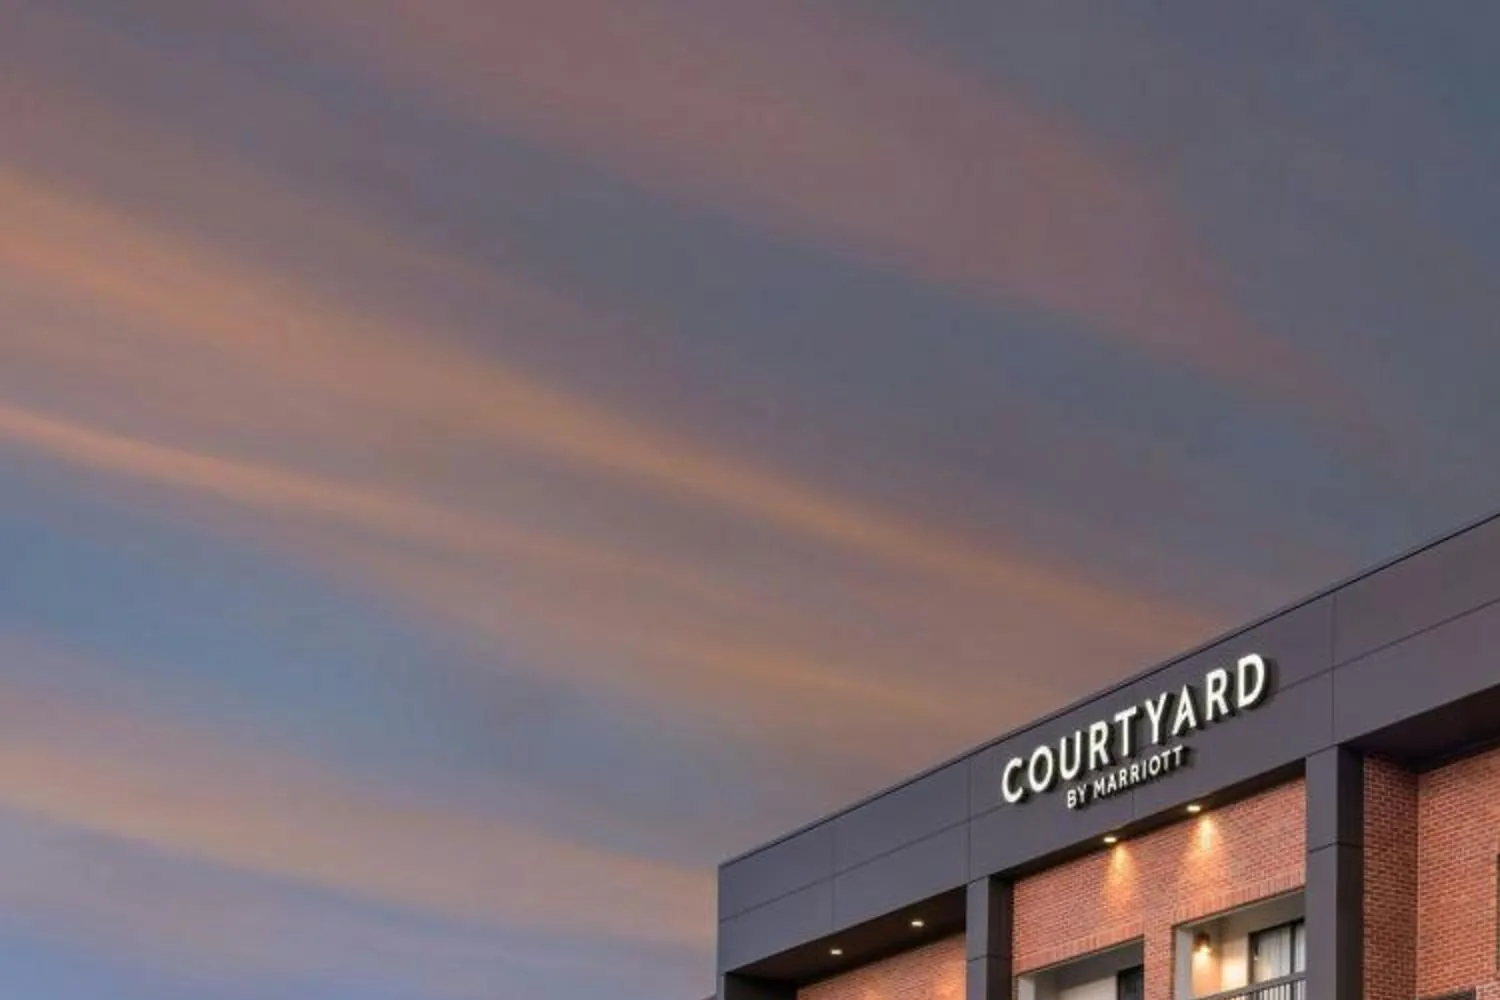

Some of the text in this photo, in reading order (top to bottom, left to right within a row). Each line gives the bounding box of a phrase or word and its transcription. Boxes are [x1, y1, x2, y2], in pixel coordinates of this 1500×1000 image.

[1001, 652, 1265, 803] COURTYARD
[1066, 744, 1184, 809] BY MARRIOTT
